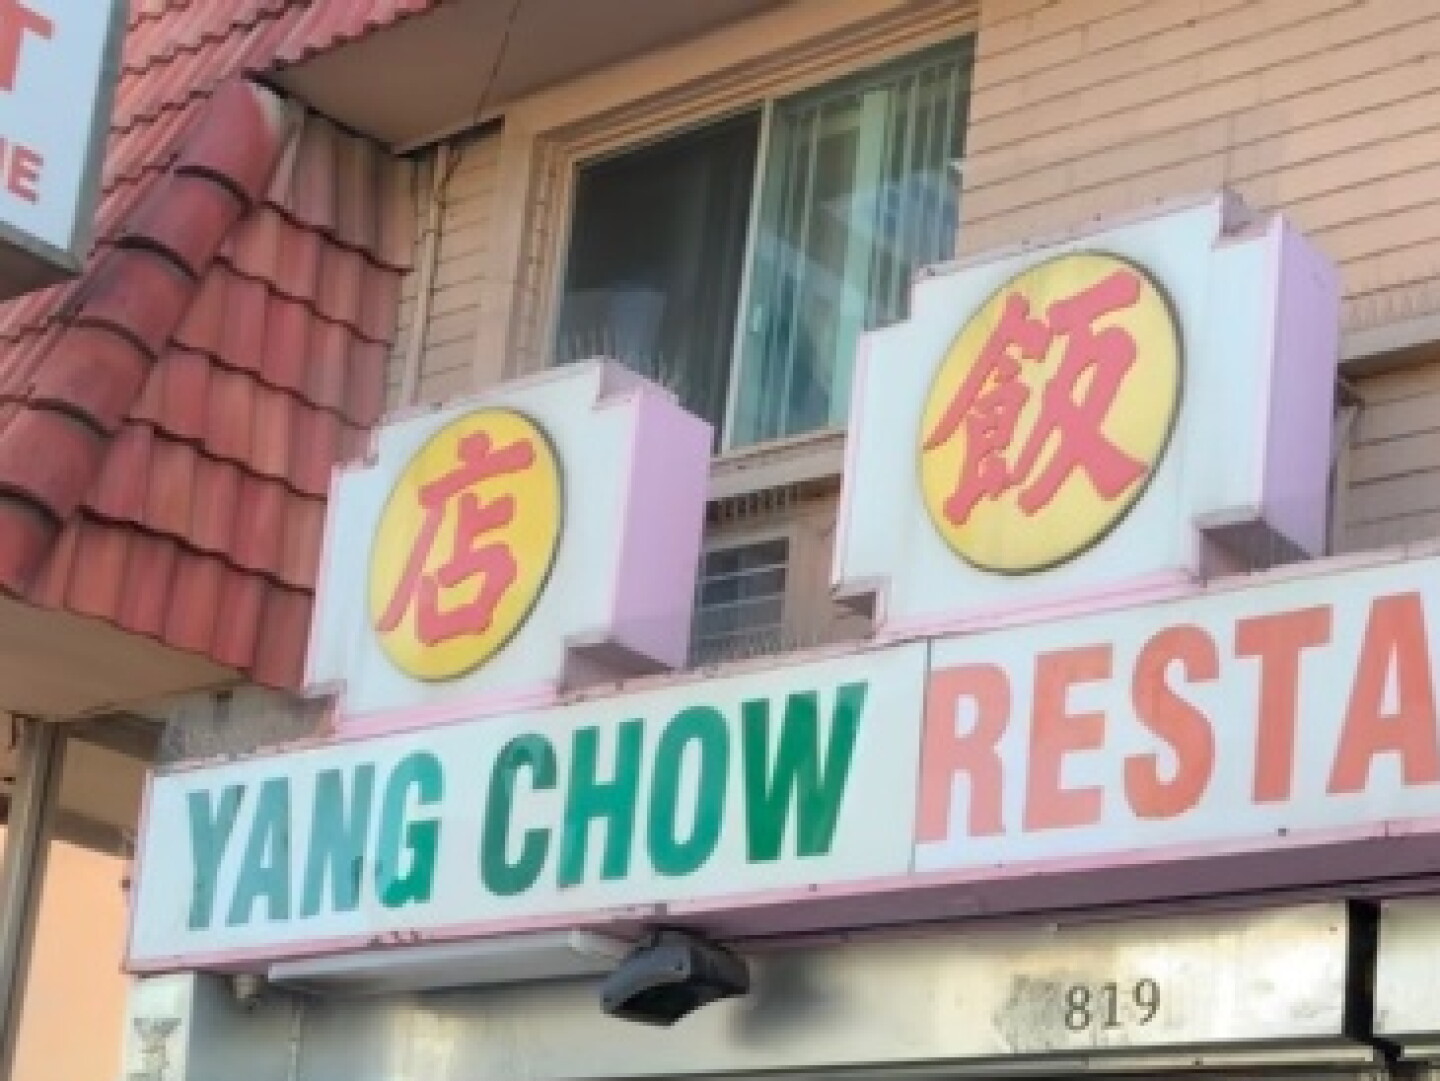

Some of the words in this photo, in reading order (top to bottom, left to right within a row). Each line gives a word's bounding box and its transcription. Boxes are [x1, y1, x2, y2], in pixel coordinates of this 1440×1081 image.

[922, 268, 1149, 525] 飯
[378, 430, 535, 648] 店
[186, 749, 446, 931] YANG
[480, 681, 868, 896] CHOW
[1065, 978, 1160, 1031] 819
